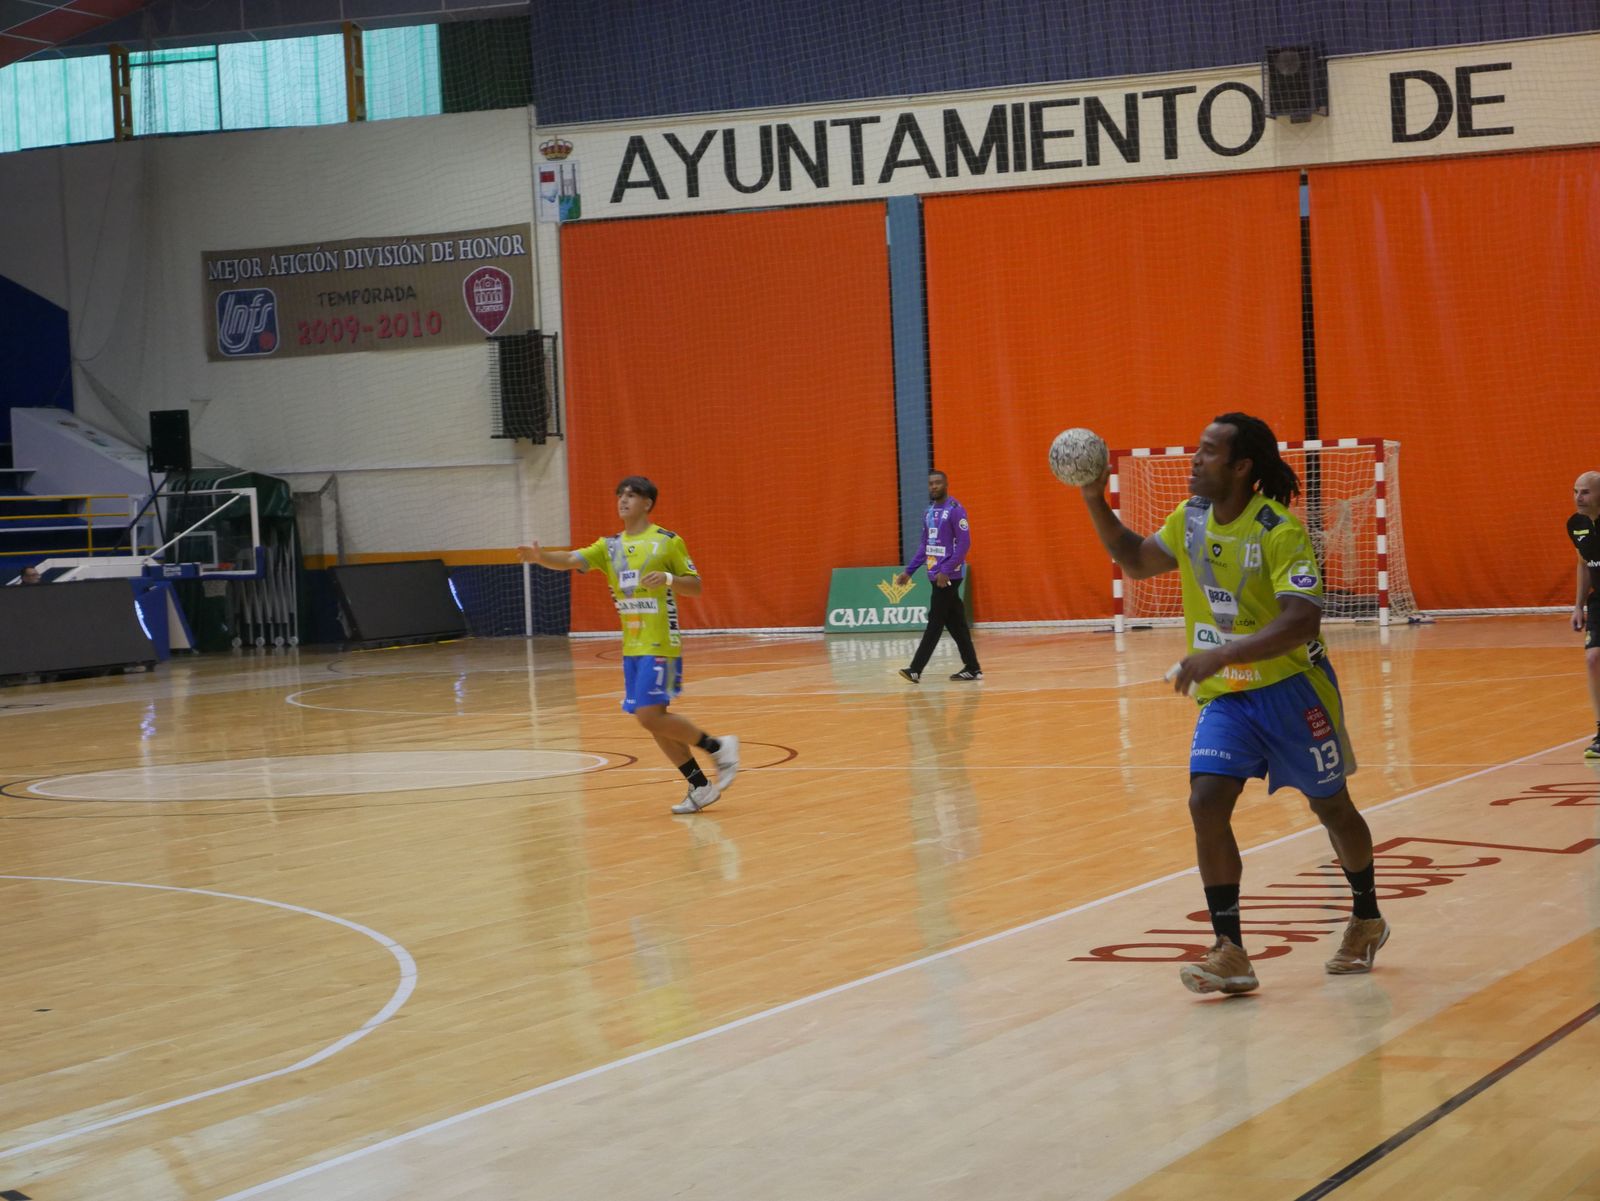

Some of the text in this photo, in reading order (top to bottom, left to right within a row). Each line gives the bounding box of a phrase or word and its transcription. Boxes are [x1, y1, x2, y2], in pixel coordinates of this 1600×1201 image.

[610, 62, 1514, 203] AYUNTAMIENTO DE
[208, 234, 526, 283] MEJOR AFICIÓN DIVISIÓN DE HONOR
[317, 285, 417, 309] TEMPORADA
[296, 310, 442, 345] 2009-2010
[651, 541, 659, 555] 7
[1244, 543, 1262, 568] 13
[829, 606, 929, 627] CAJA RUR
[653, 666, 664, 686] 7
[1309, 740, 1340, 772] 13
